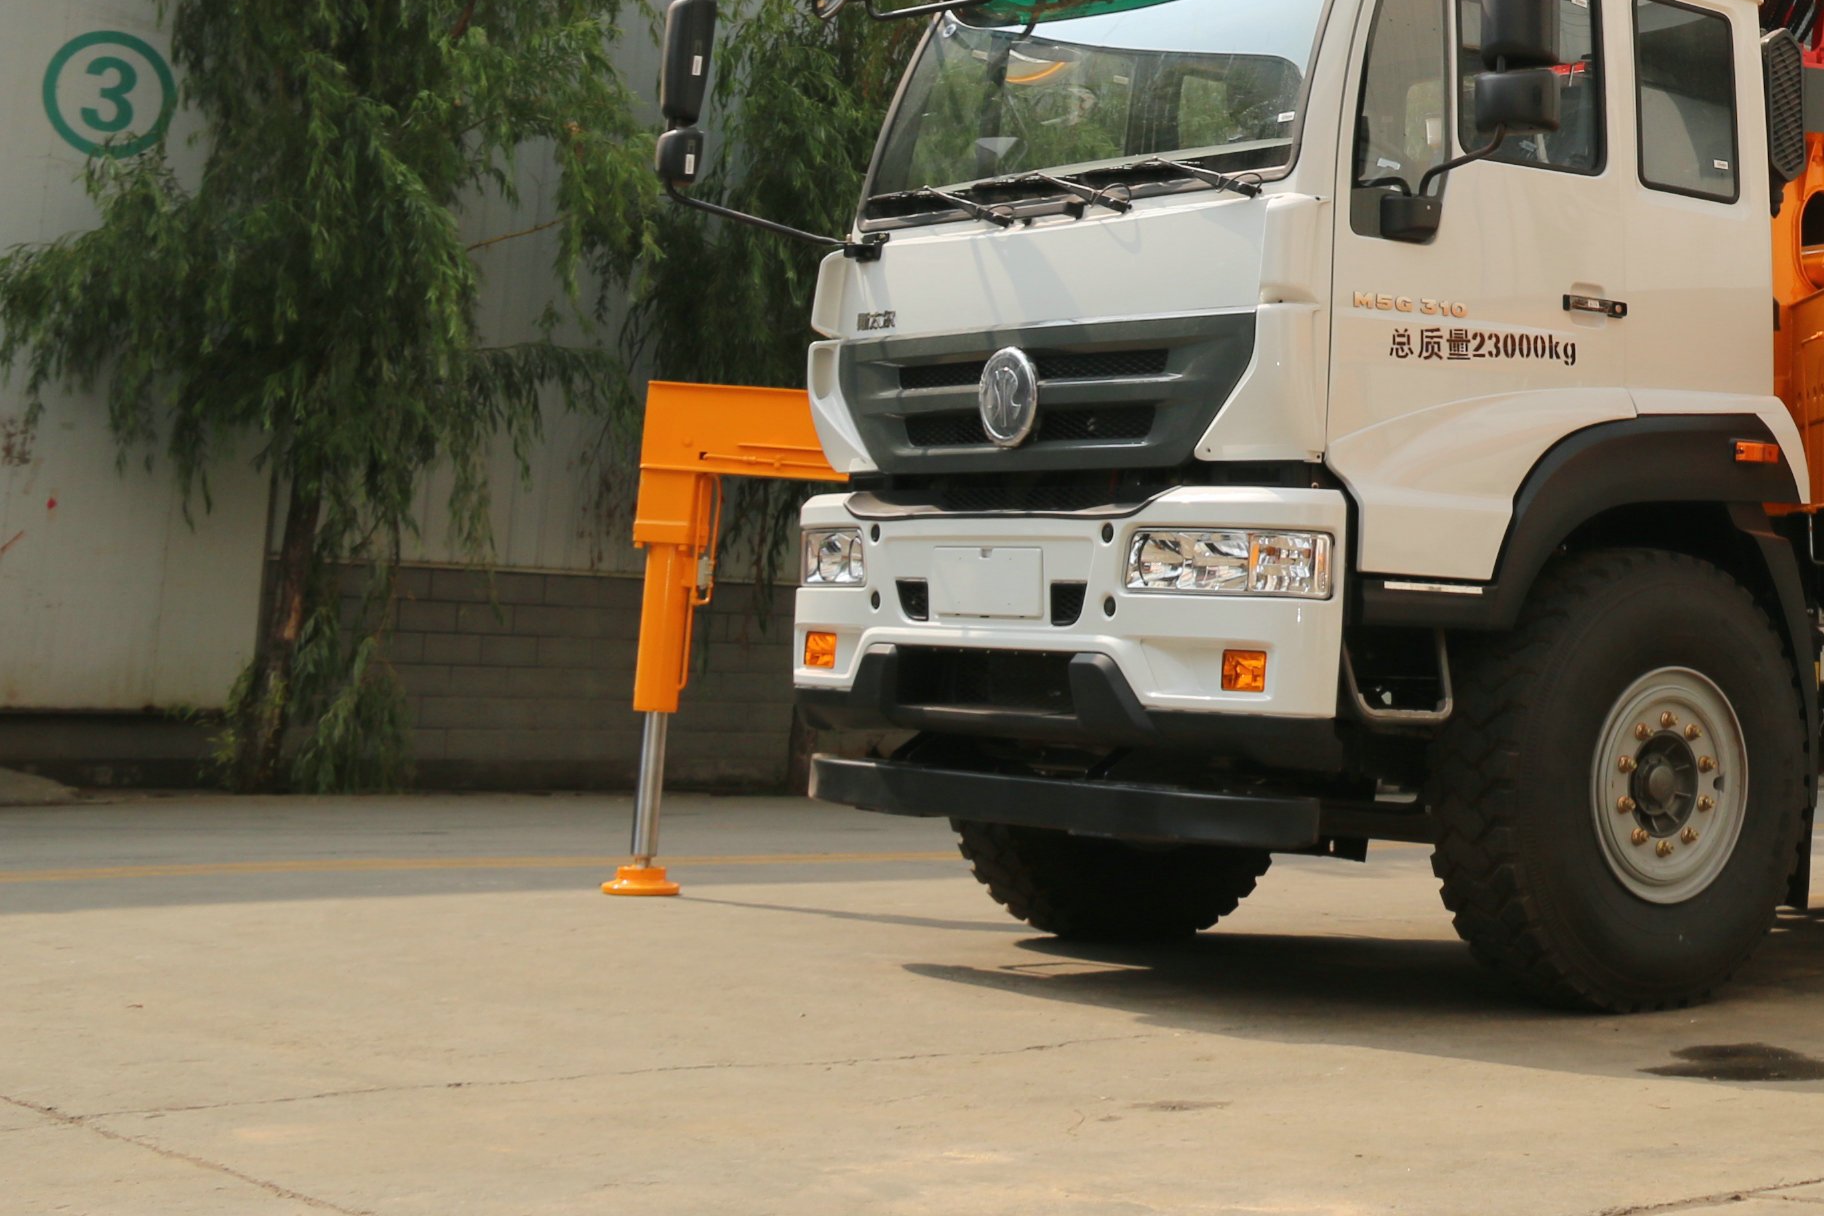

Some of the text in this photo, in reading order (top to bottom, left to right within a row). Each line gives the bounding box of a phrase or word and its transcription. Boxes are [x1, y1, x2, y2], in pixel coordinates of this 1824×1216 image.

[81, 56, 137, 132] 3
[1353, 291, 1468, 318] M5G 310
[1389, 328, 1576, 366] 总质量23000kg
